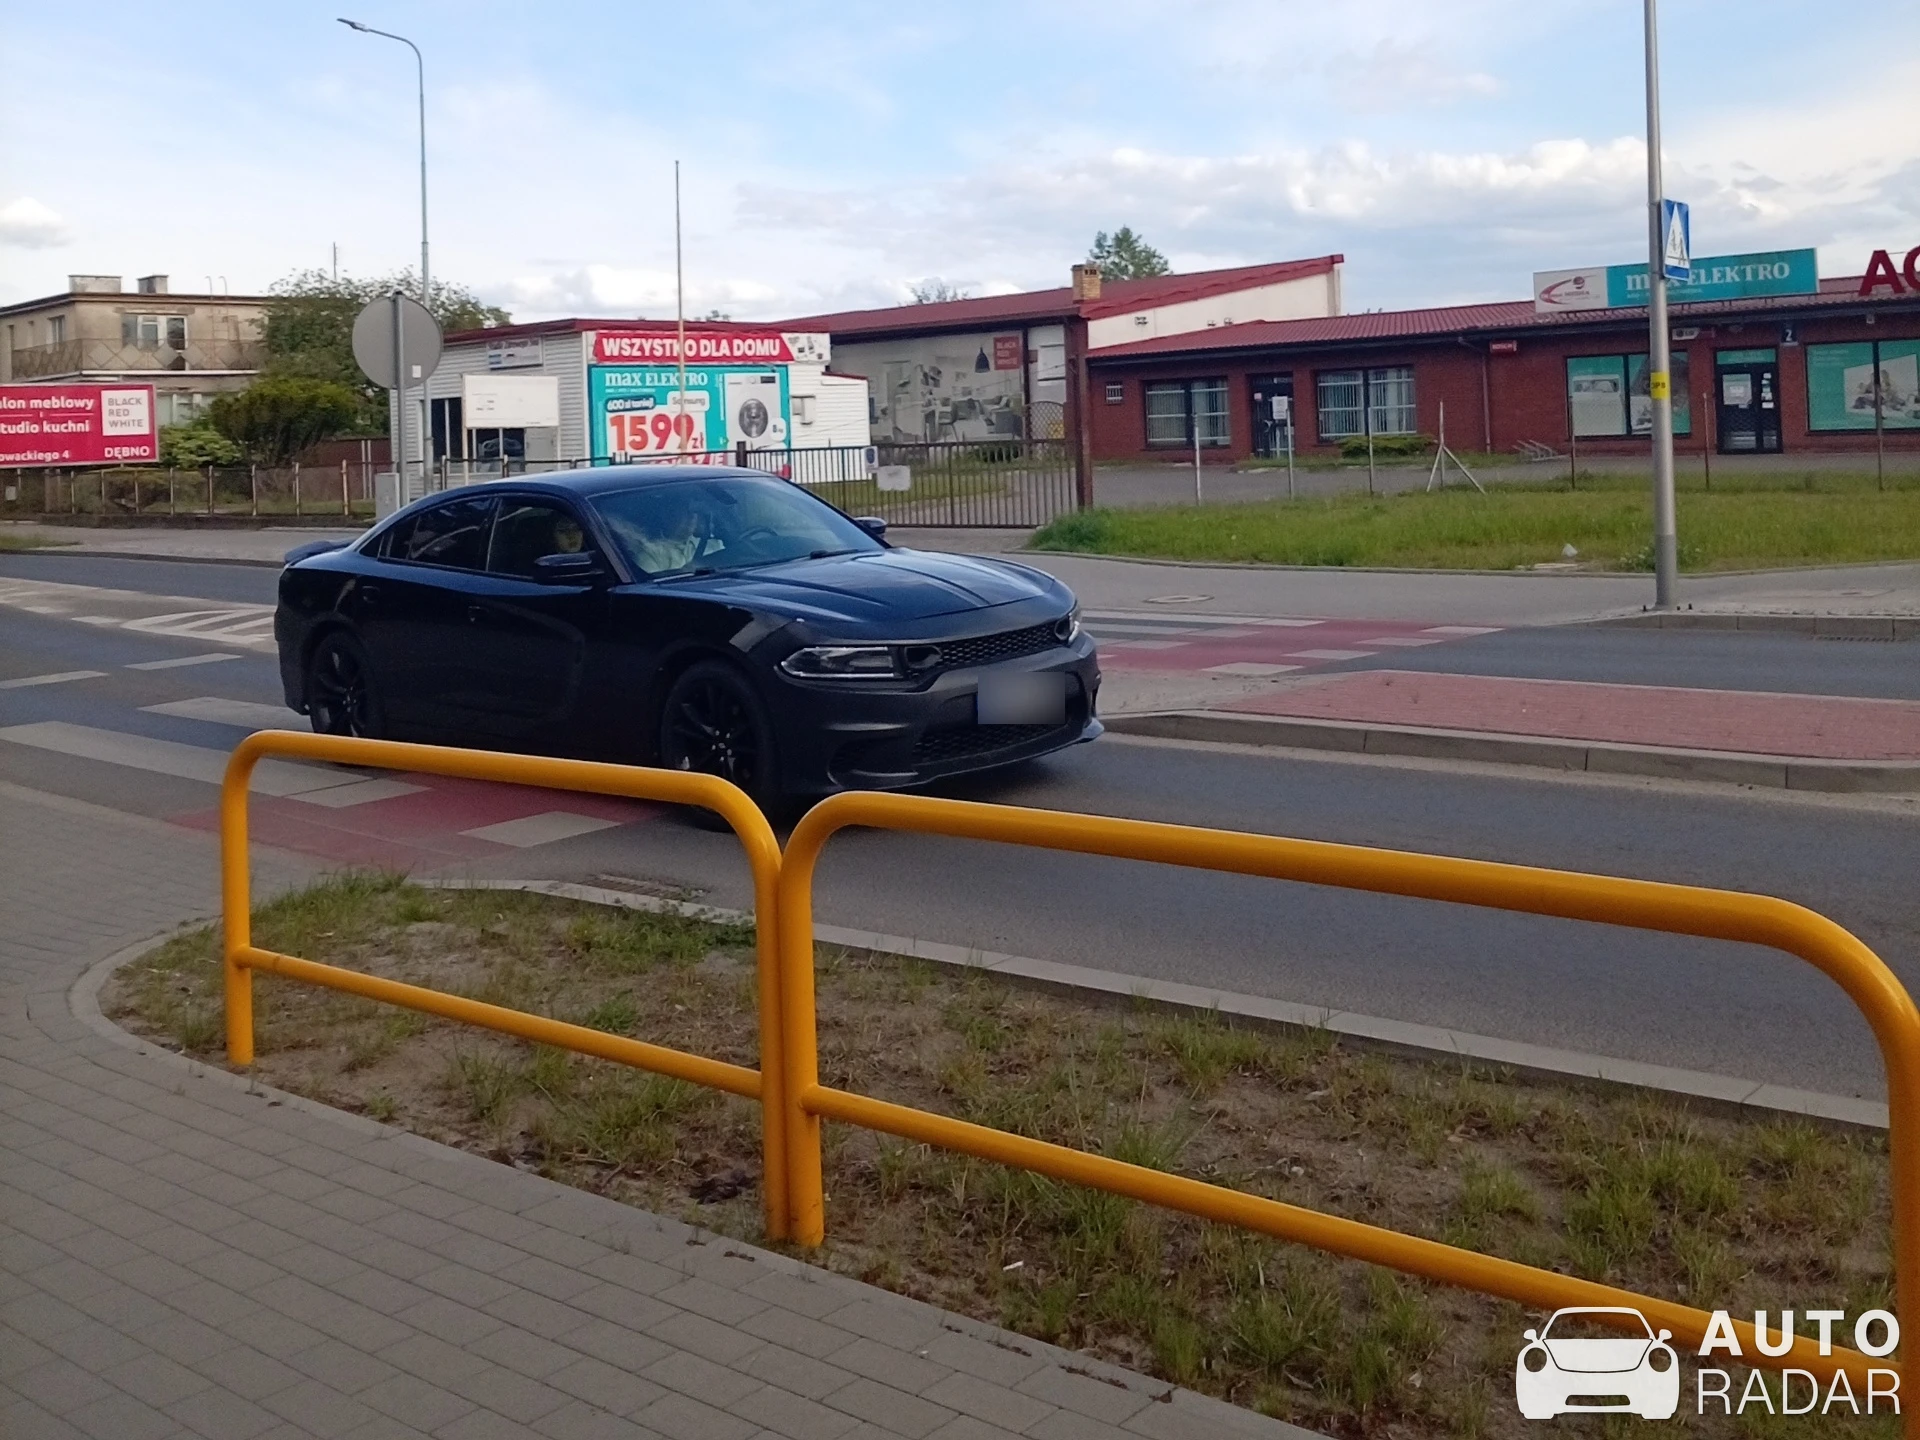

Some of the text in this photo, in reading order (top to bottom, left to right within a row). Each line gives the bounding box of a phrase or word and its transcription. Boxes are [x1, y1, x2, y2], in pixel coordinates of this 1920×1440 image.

[1687, 262, 1790, 286] ELEKTRO
[1785, 329, 1793, 341] 2
[602, 337, 780, 357] WSZYSTKO DLA DOMU
[605, 372, 709, 387] max ELEKTRO
[30, 396, 94, 410] meblowy
[108, 397, 143, 406] BLACK
[607, 400, 625, 411] 600
[108, 408, 130, 417] RED
[0, 419, 90, 434] tudio kuchni
[108, 418, 144, 428] WHITE
[609, 413, 705, 452] 1599 zł
[62, 449, 70, 459] 4
[104, 445, 150, 460] DĘBNO
